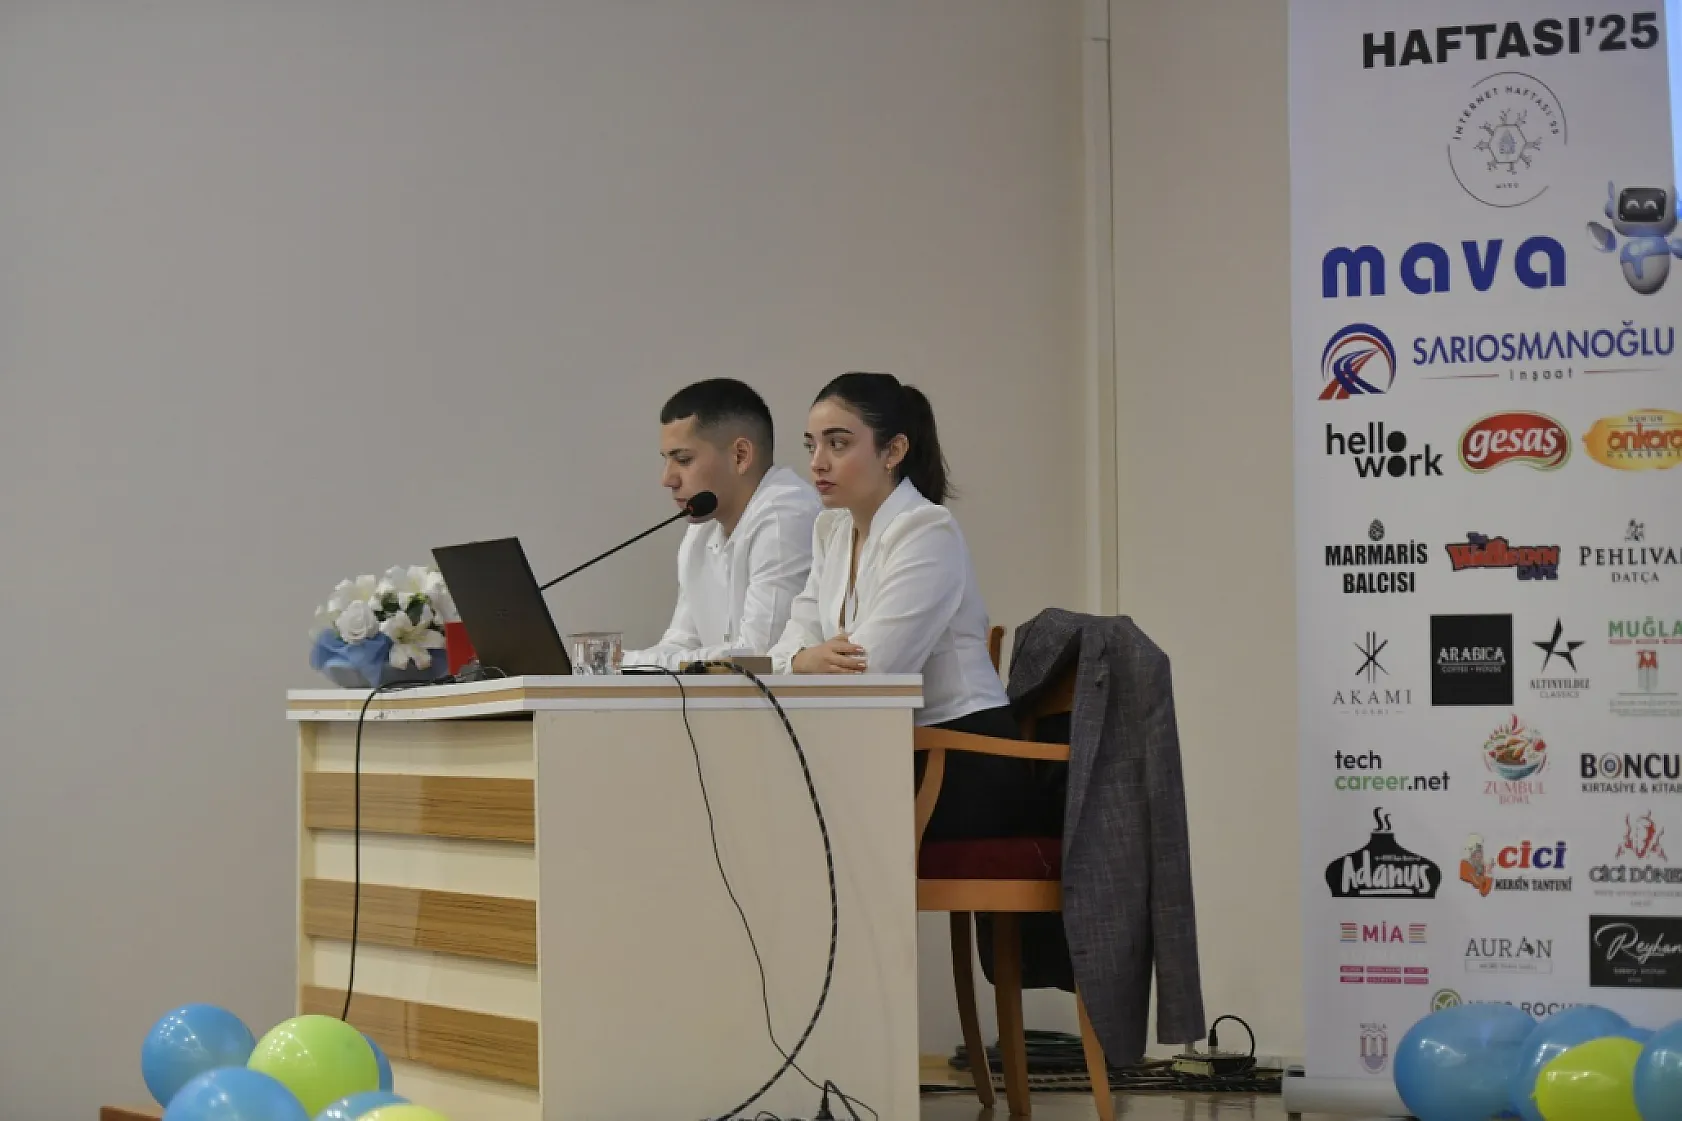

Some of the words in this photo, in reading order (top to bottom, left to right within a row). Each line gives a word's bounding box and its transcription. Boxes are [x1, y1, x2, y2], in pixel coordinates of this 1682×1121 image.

[1362, 12, 1660, 69] HAFTASI'25
[1322, 235, 1567, 298] mava
[1326, 421, 1407, 455] hello
[1465, 425, 1559, 462] gesaş
[1354, 443, 1444, 478] work
[1325, 540, 1428, 567] MARMARİS
[1343, 572, 1415, 594] BALCISI
[1335, 750, 1382, 769] tech
[1334, 771, 1450, 791] career.net
[1362, 920, 1405, 944] MİA
